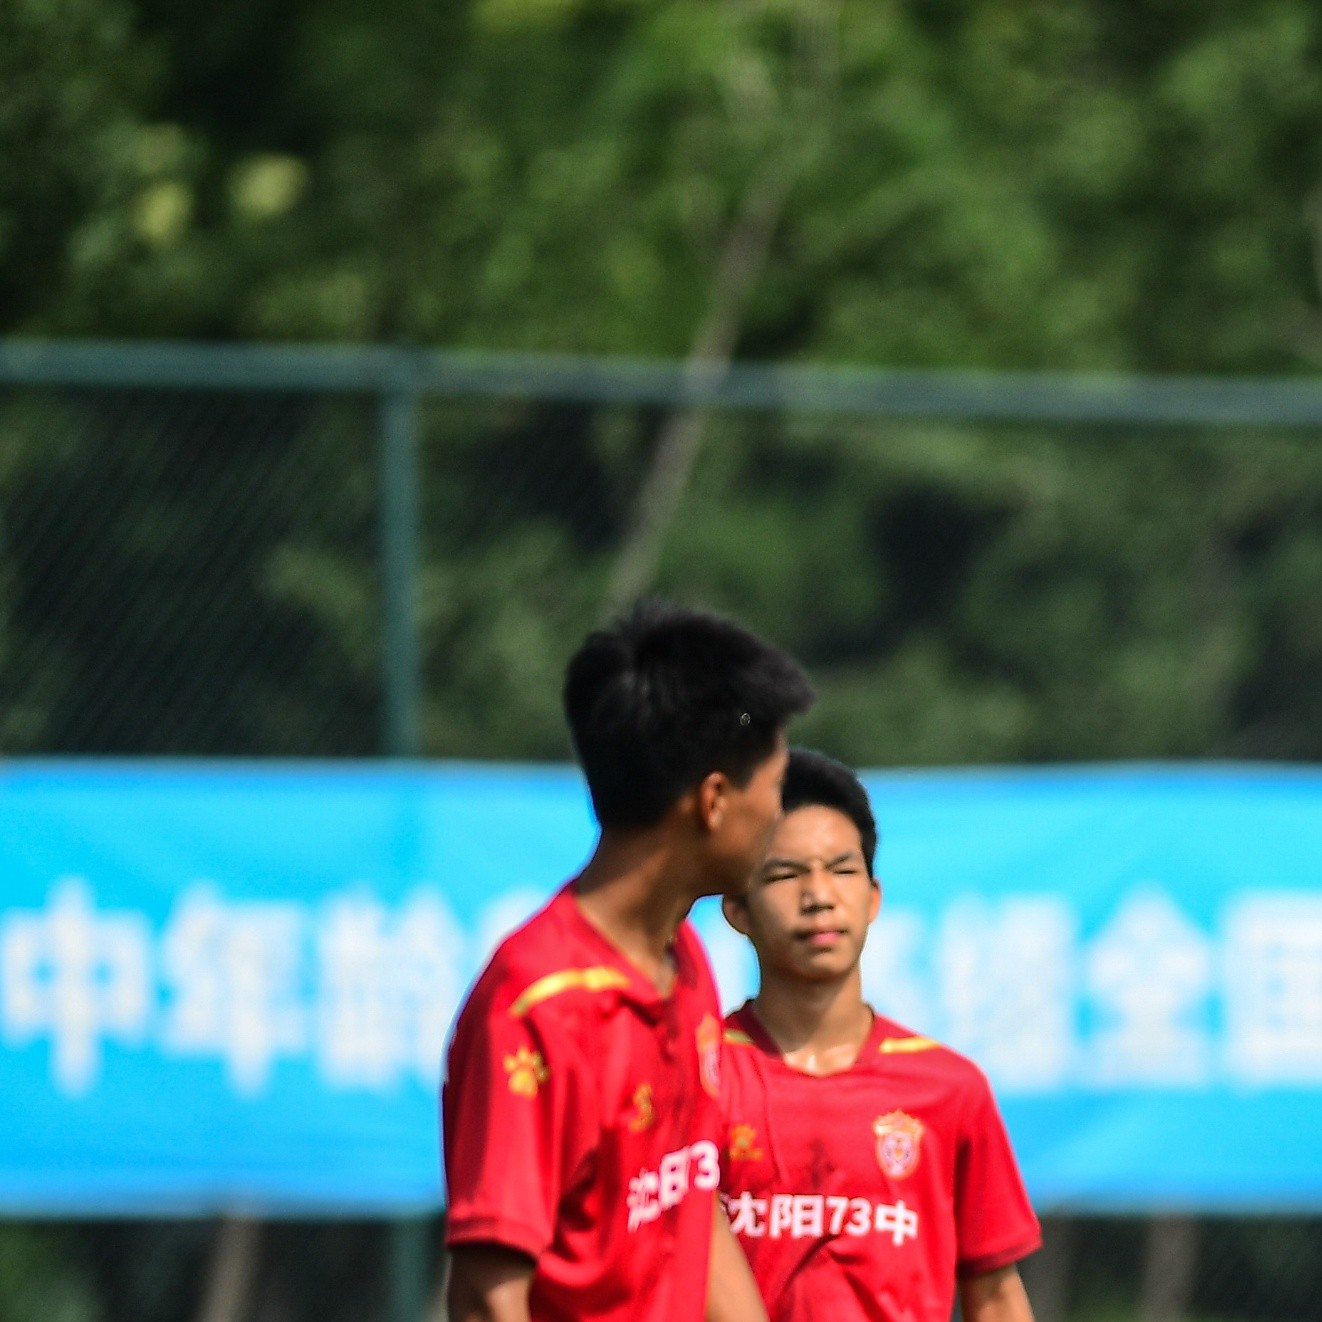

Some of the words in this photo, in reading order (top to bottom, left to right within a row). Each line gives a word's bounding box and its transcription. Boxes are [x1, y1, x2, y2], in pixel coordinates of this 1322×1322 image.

[2, 876, 548, 1100] 中年龄
[720, 1191, 918, 1247] 沈阳73中
